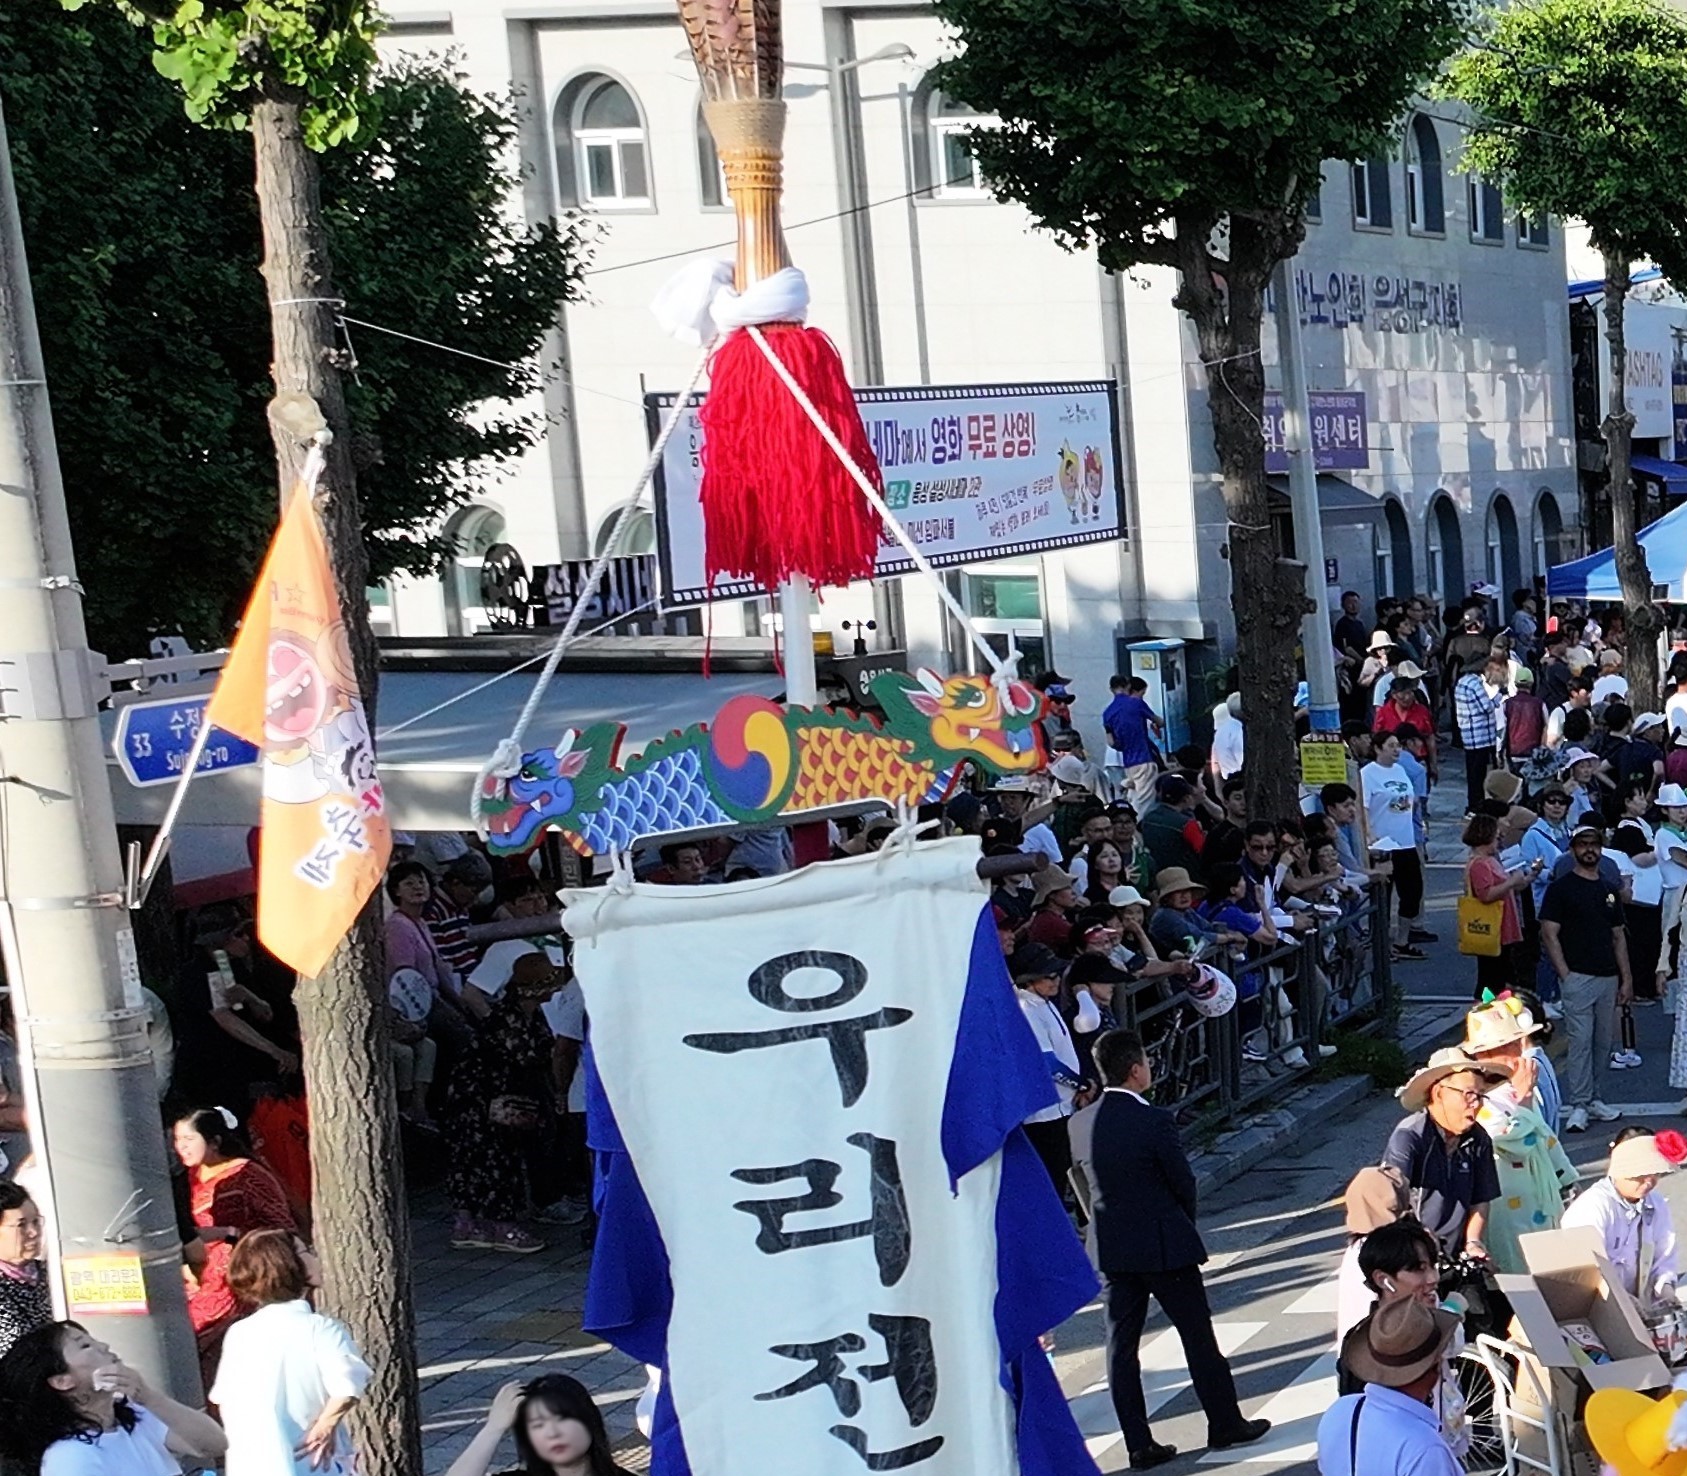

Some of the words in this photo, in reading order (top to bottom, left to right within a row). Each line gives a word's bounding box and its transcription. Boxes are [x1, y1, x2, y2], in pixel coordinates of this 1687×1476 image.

[1624, 352, 1663, 388] ASHTAG
[931, 417, 963, 464] 영화
[967, 416, 998, 461] 무료
[1001, 412, 1037, 457] 상영!
[169, 707, 208, 740] 수정
[133, 733, 152, 757] 33
